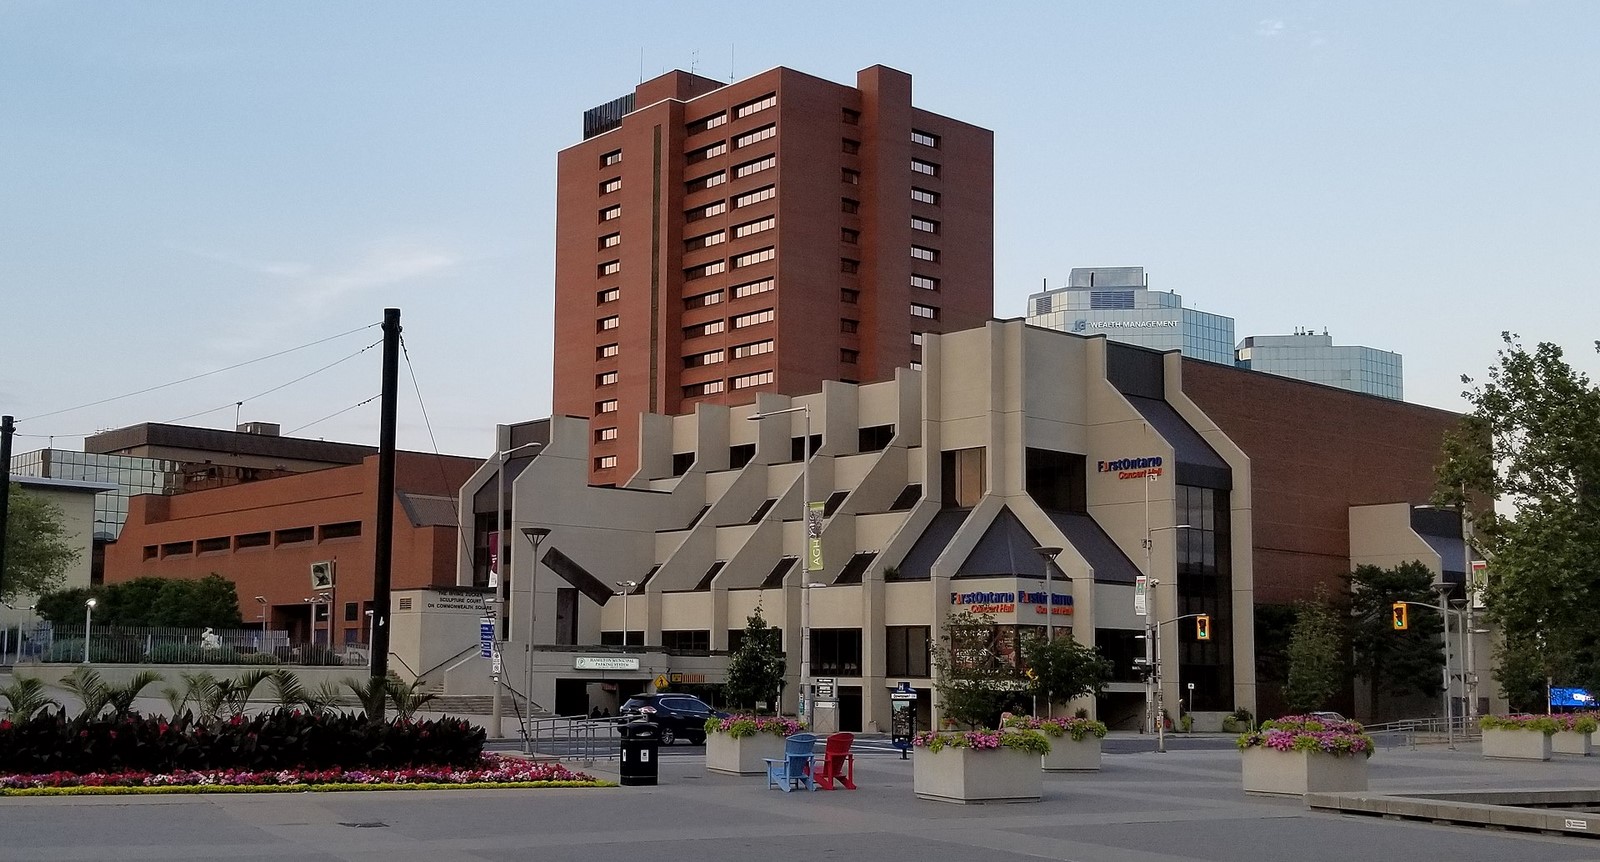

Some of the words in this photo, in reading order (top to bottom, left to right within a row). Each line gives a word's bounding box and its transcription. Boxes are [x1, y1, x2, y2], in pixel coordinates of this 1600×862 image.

[1122, 320, 1178, 328] MANAGEMENT
[1097, 457, 1163, 472] FirstOntario
[1119, 470, 1147, 479] Concert
[813, 540, 821, 566] AGH
[950, 592, 1015, 605] FirstOntario
[971, 605, 1000, 613] Concert
[1000, 604, 1015, 613] Hall
